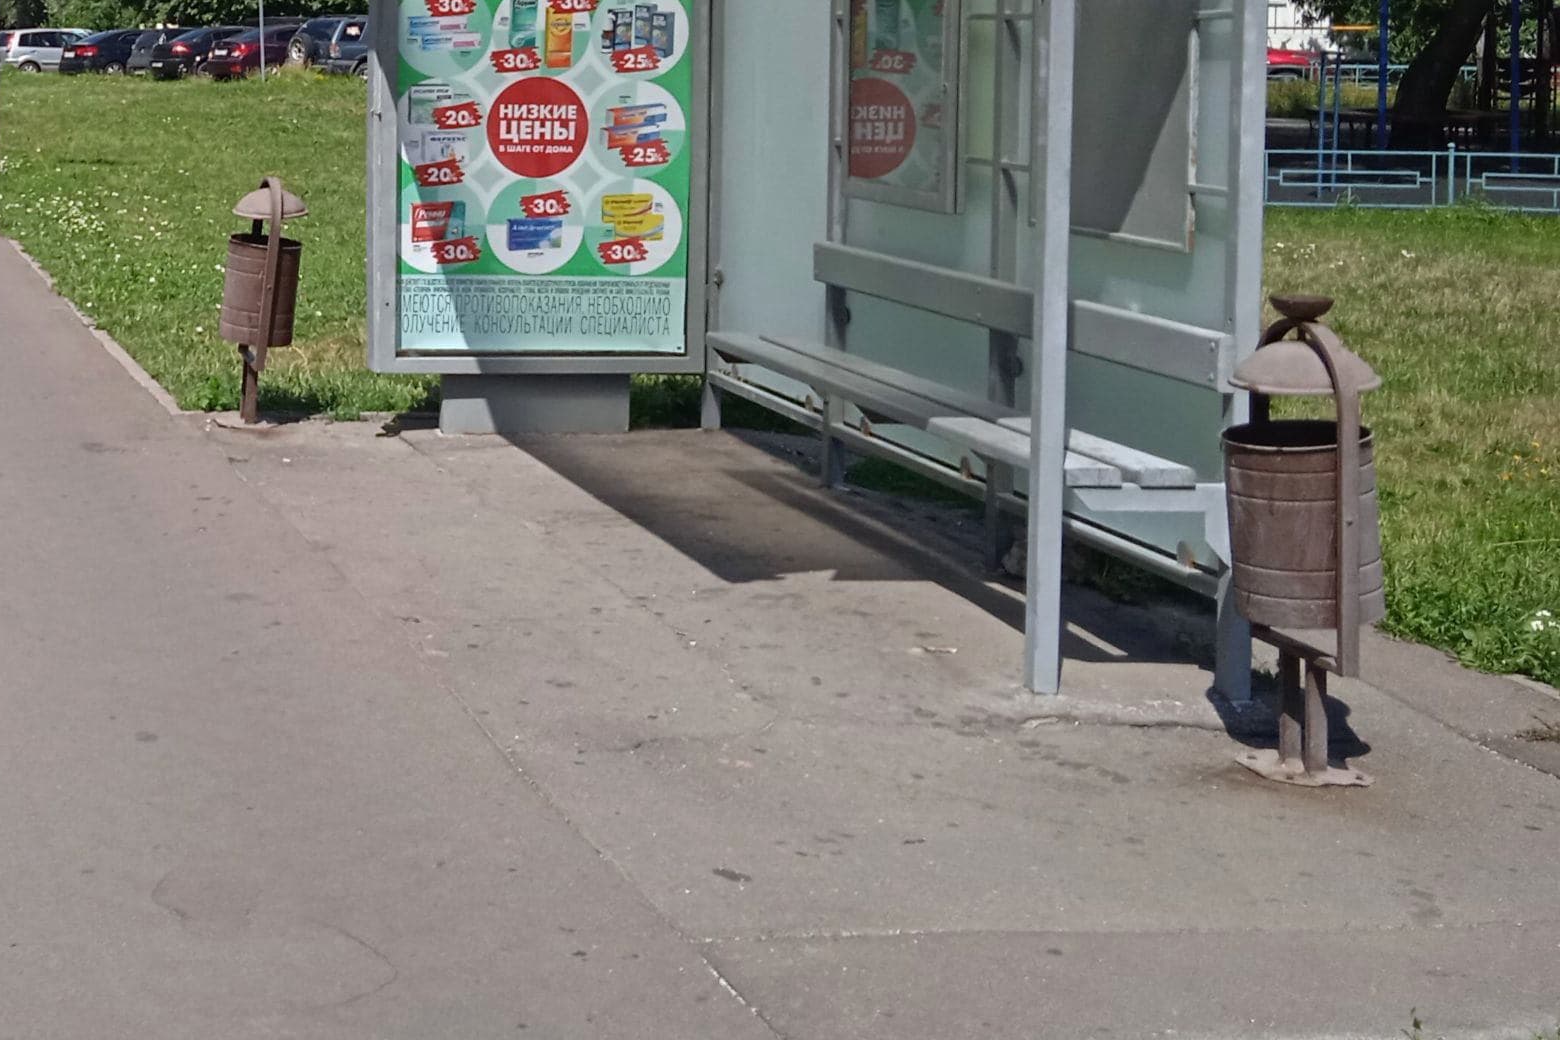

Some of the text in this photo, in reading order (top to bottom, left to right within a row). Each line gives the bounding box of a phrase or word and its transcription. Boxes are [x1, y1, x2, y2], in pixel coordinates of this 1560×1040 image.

[499, 104, 577, 119] НИЗКИЕ
[499, 120, 576, 143] ЦЕНЫ
[499, 144, 573, 154] В ШАГЕ ОТ ДОМА
[402, 293, 452, 313] МЕЮТСЯ
[588, 295, 671, 316] НЕОБХОДИМО
[402, 313, 671, 336] ОЛУЧЕНИЕ КОНСУЛЬТАЦИИ СПЕЦИАЛИСТА
